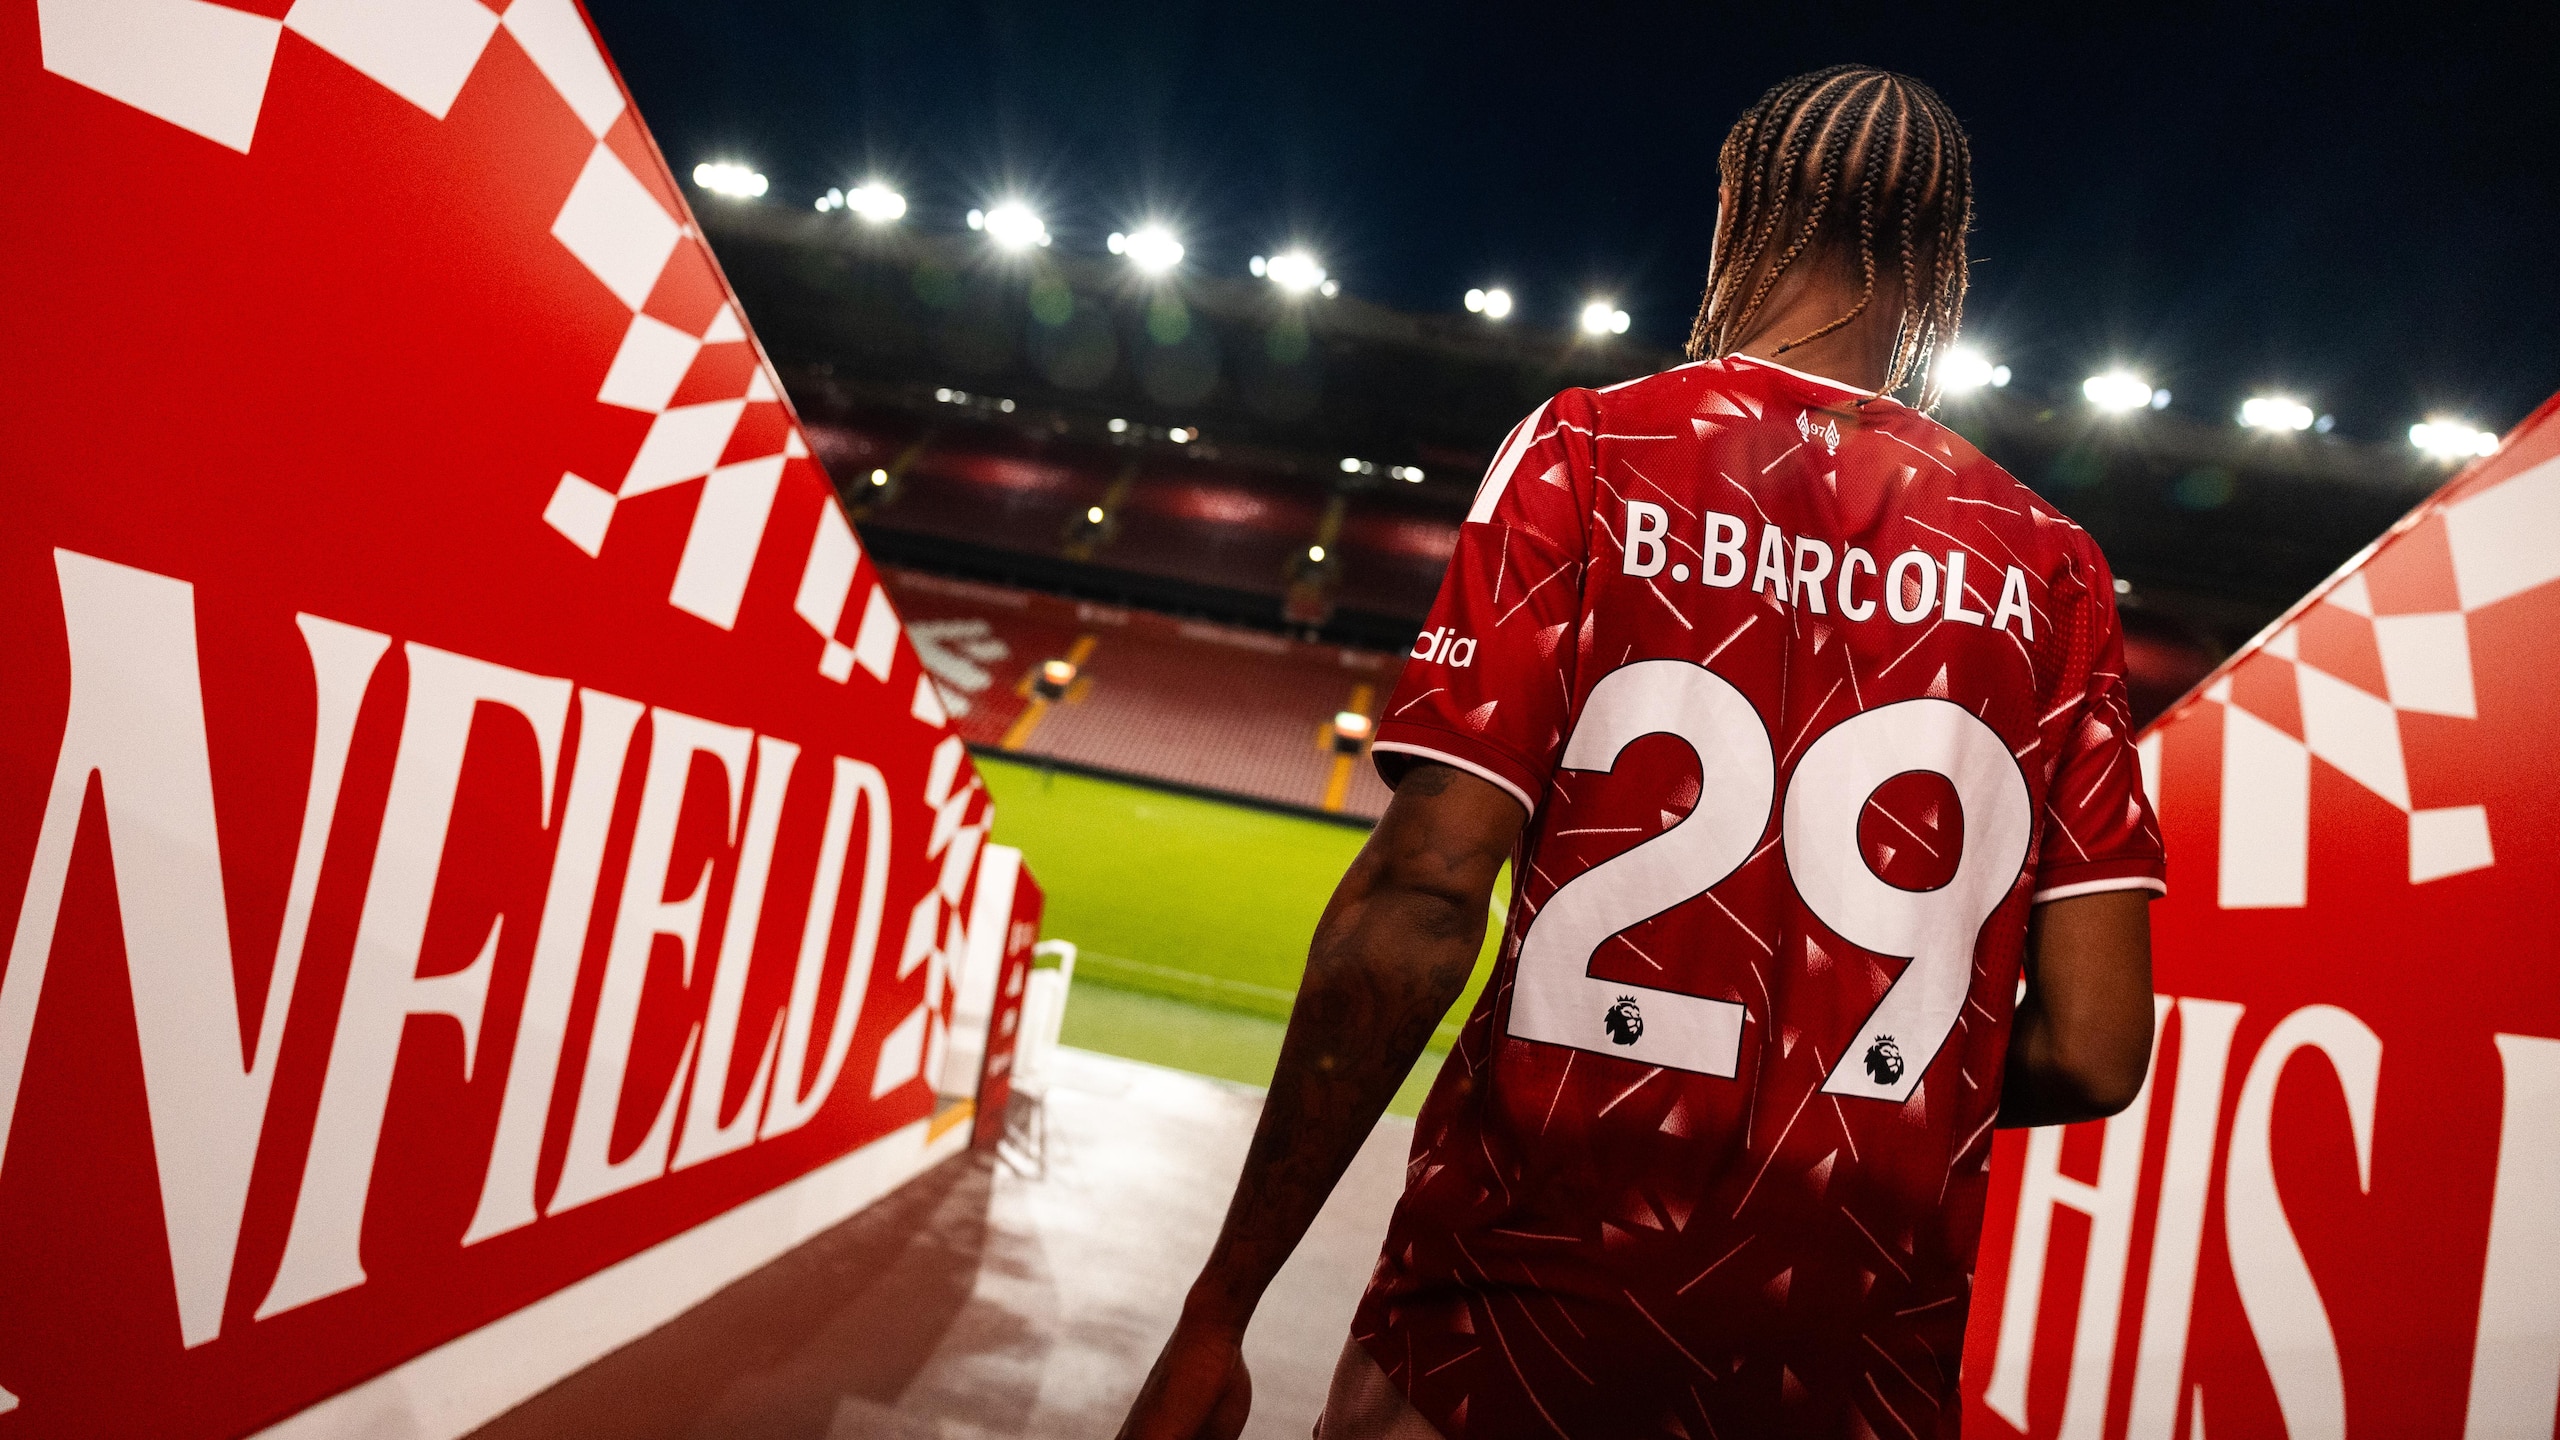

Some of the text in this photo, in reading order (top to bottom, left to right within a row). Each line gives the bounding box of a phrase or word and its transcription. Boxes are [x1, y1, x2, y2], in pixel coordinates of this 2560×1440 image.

[1810, 423, 1826, 437] 97
[1622, 500, 2036, 643] B.BARCOLA
[1410, 626, 1478, 668] dia
[1507, 658, 2034, 1103] 29
[1983, 978, 2384, 1440] HIS
